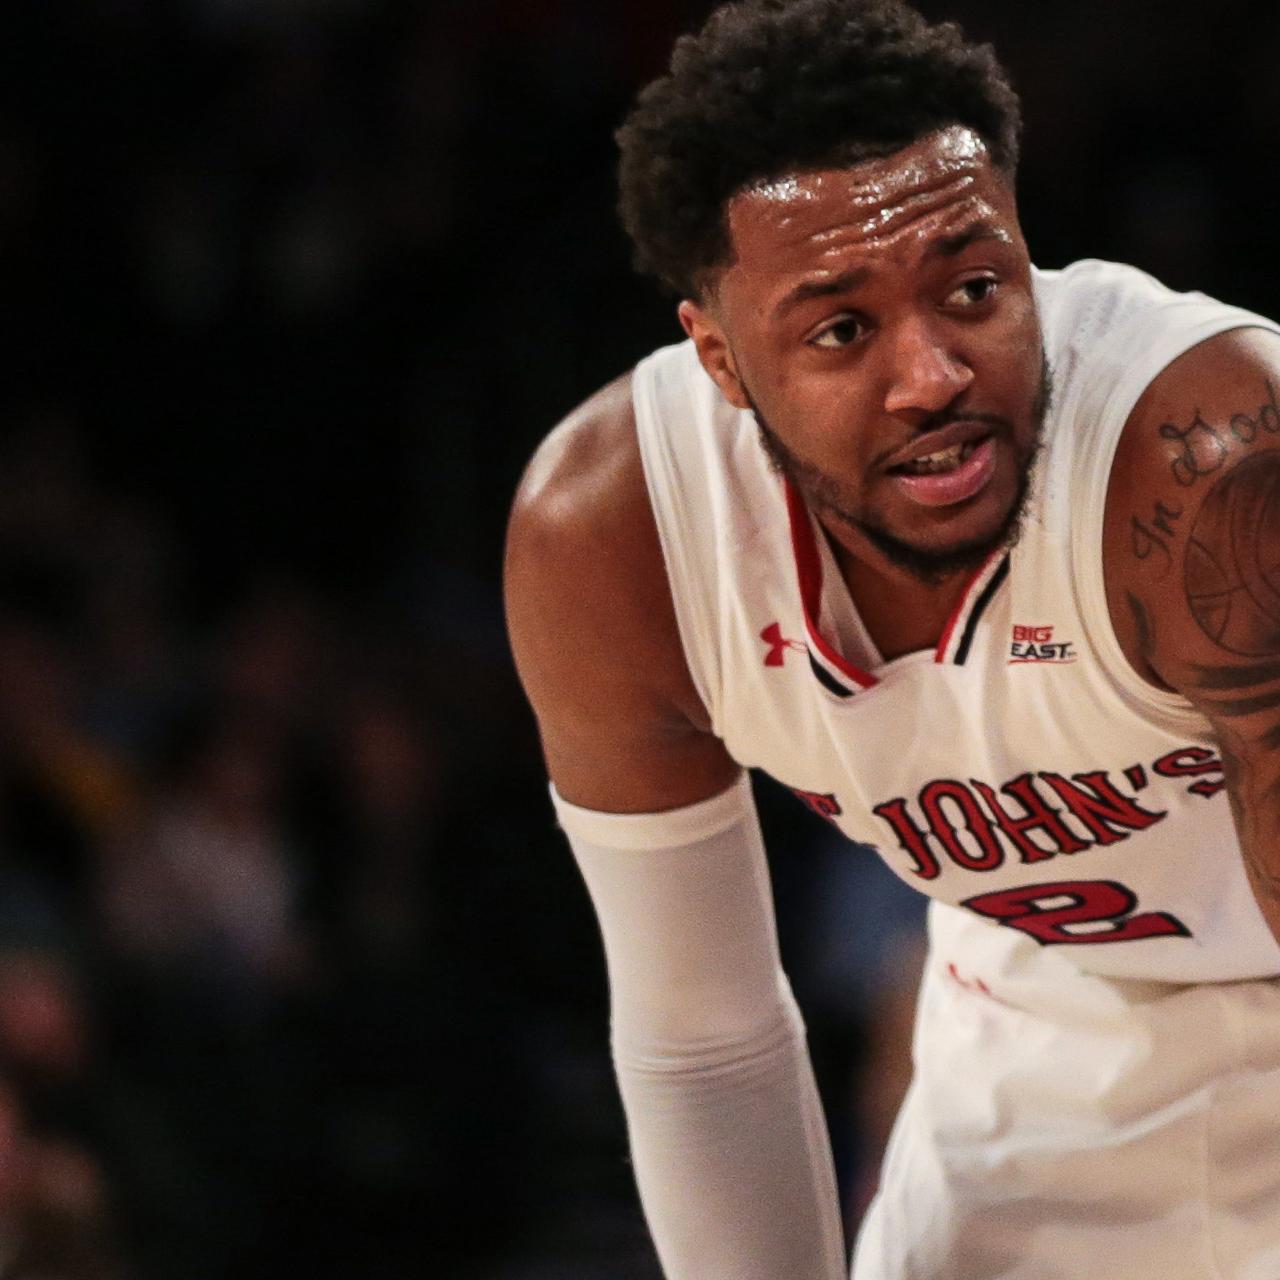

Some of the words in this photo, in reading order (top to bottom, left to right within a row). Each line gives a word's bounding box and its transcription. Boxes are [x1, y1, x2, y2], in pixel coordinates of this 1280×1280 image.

[1011, 642, 1073, 659] EAST
[1013, 625, 1054, 642] BIG
[872, 746, 1224, 881] JOHN'S
[960, 880, 1193, 946] 2
